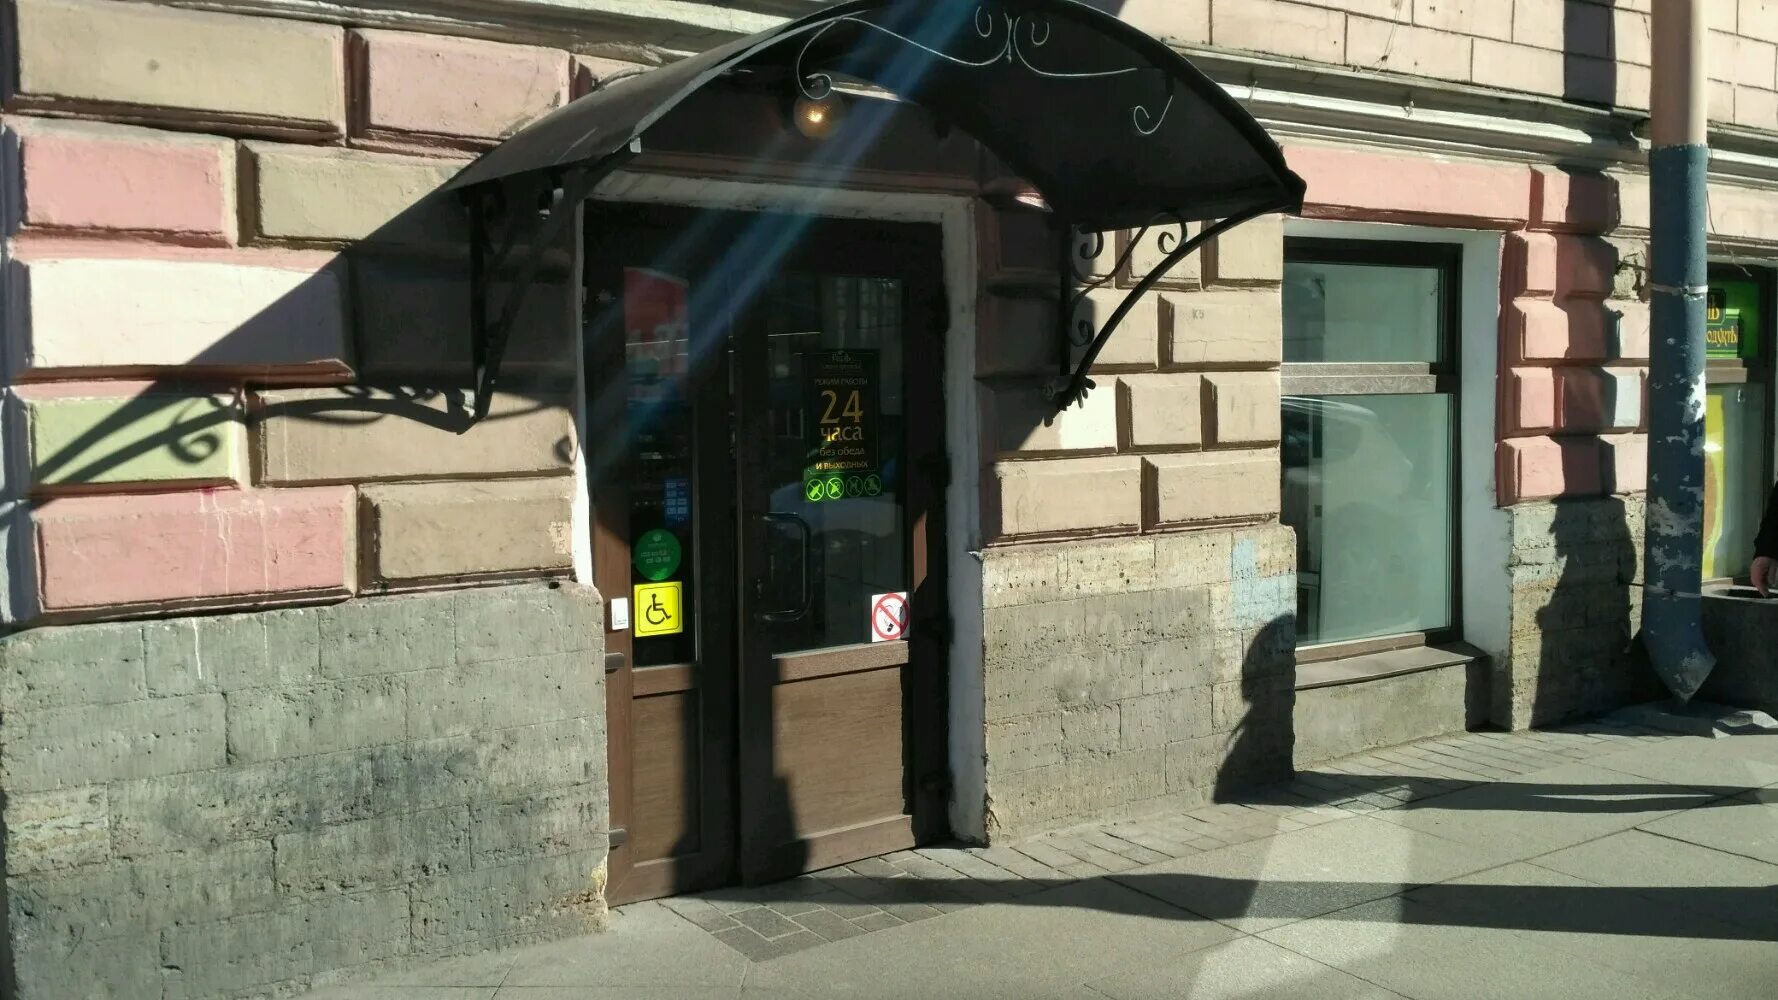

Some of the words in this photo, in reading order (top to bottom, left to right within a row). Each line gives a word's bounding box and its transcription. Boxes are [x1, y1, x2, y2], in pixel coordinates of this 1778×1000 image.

[820, 390, 864, 424] 24
[820, 425, 863, 441] часа
[820, 447, 836, 457] без
[837, 446, 865, 457] обеда
